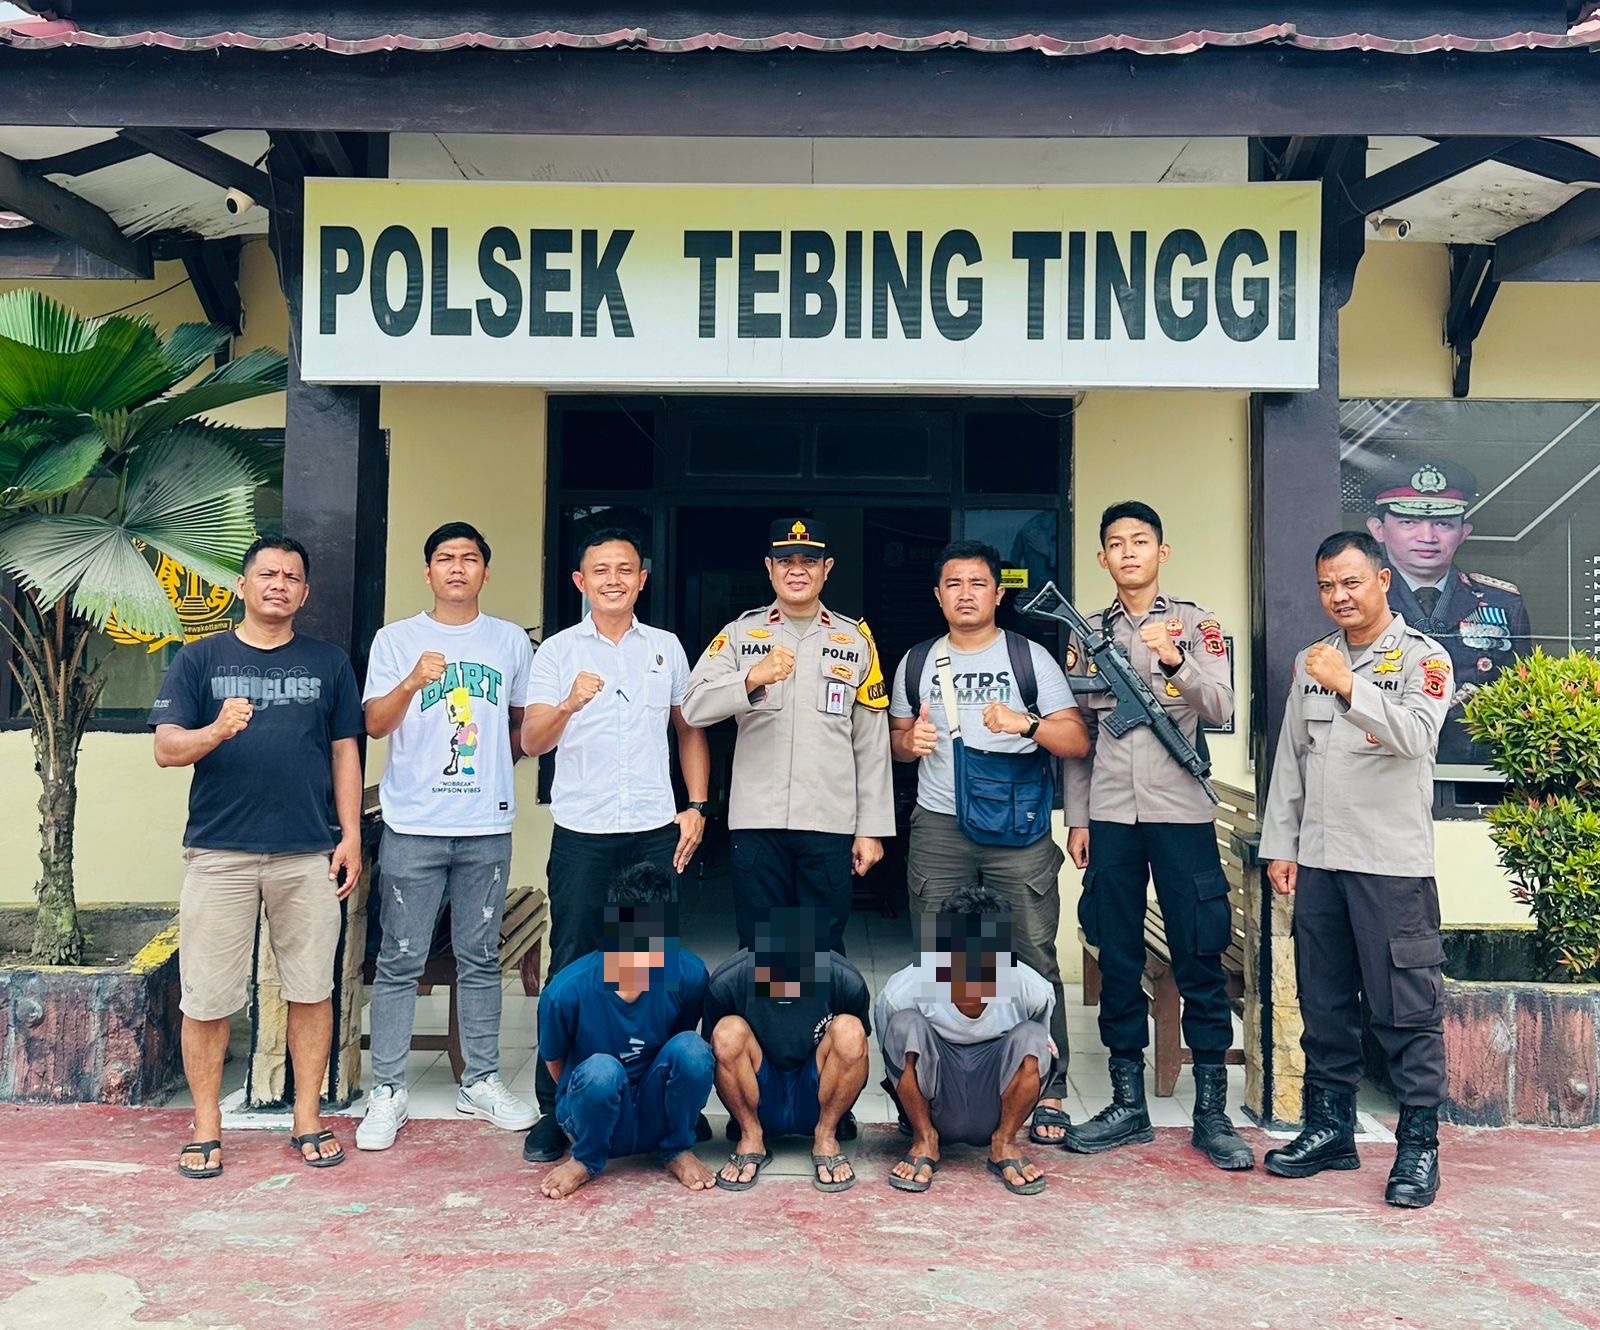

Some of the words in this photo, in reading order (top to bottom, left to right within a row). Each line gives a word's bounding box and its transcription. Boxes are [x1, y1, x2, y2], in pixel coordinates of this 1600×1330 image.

[320, 225, 635, 338] POLSEK
[684, 229, 983, 341] TEBING
[1012, 229, 1297, 342] TINGGI
[822, 647, 859, 663] POLRI
